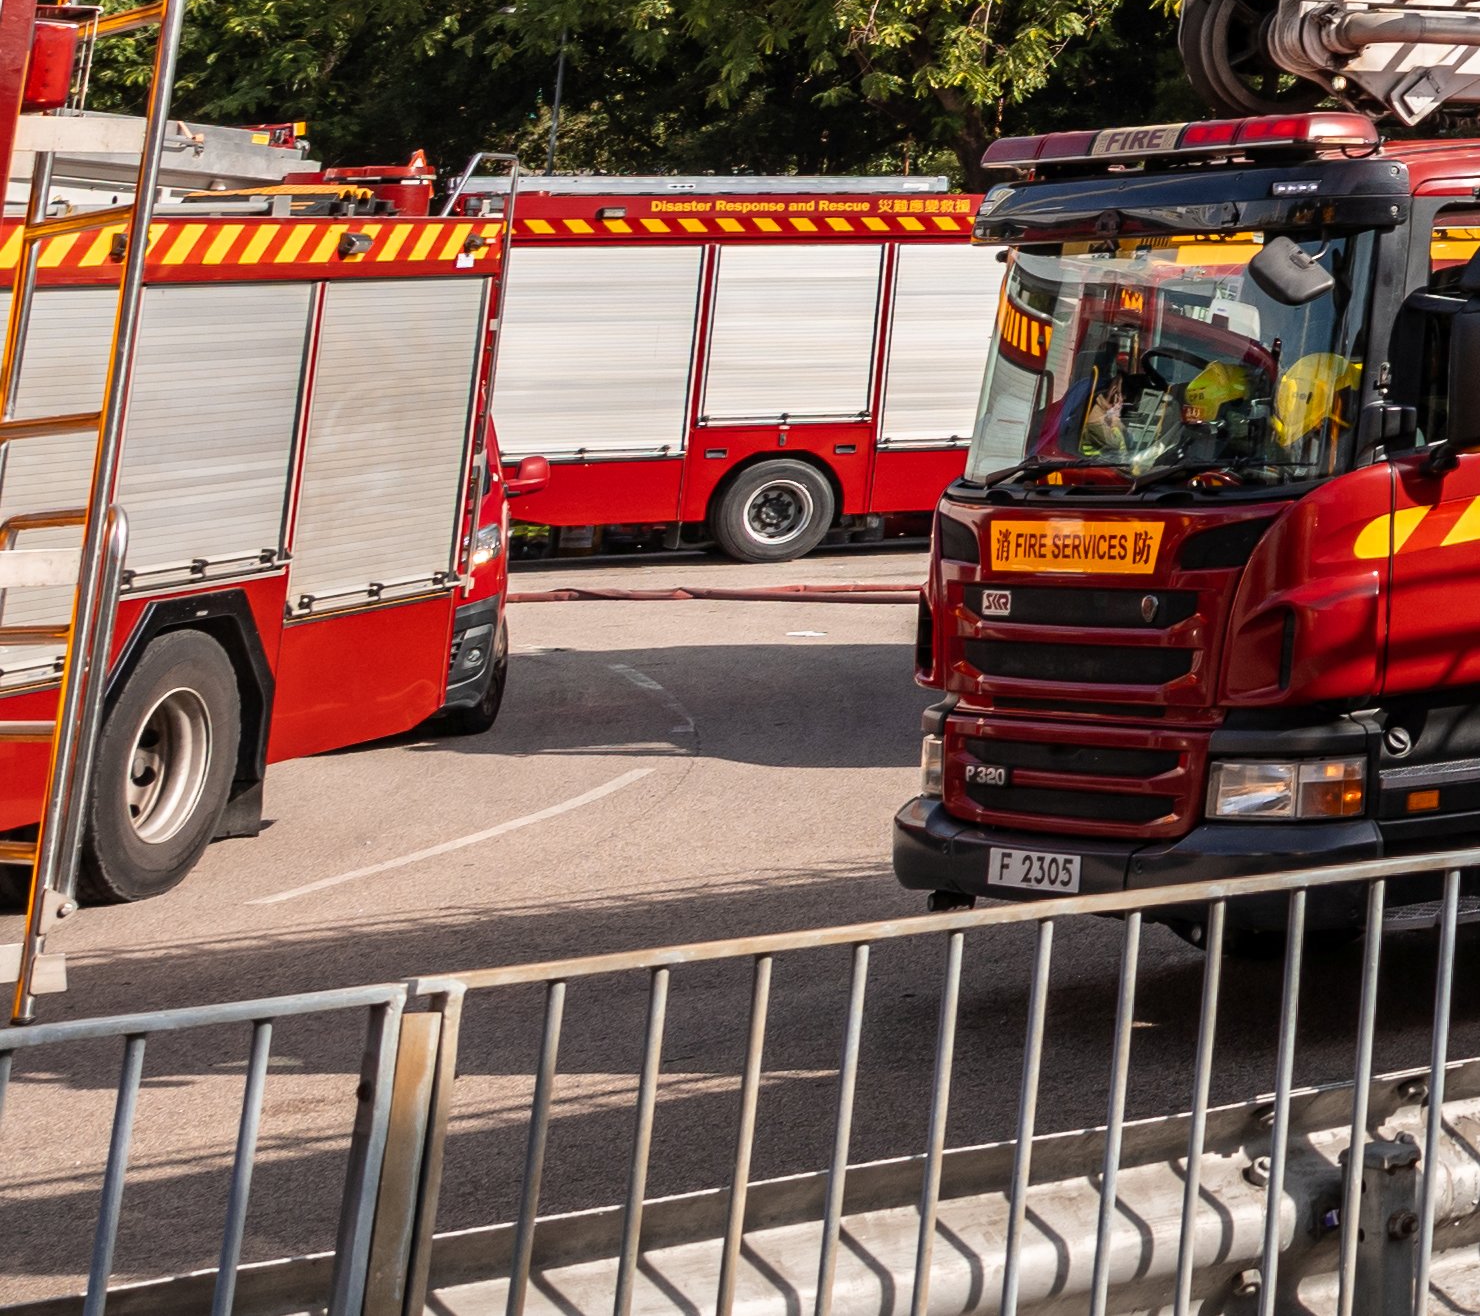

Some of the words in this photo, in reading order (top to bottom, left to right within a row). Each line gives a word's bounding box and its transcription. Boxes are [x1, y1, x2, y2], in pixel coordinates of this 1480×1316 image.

[1105, 128, 1168, 153] FIRE
[651, 200, 712, 213] Disaster
[715, 200, 785, 214] Response
[788, 200, 816, 213] and
[818, 200, 870, 212] Rescue
[996, 528, 1012, 563] 消
[1014, 533, 1048, 559] FIRE
[1051, 533, 1128, 561] SERVICES
[1132, 530, 1153, 565] 防
[965, 765, 975, 782] P
[976, 767, 1006, 786] 320
[999, 852, 1013, 881] F
[1020, 855, 1074, 887] 2305
